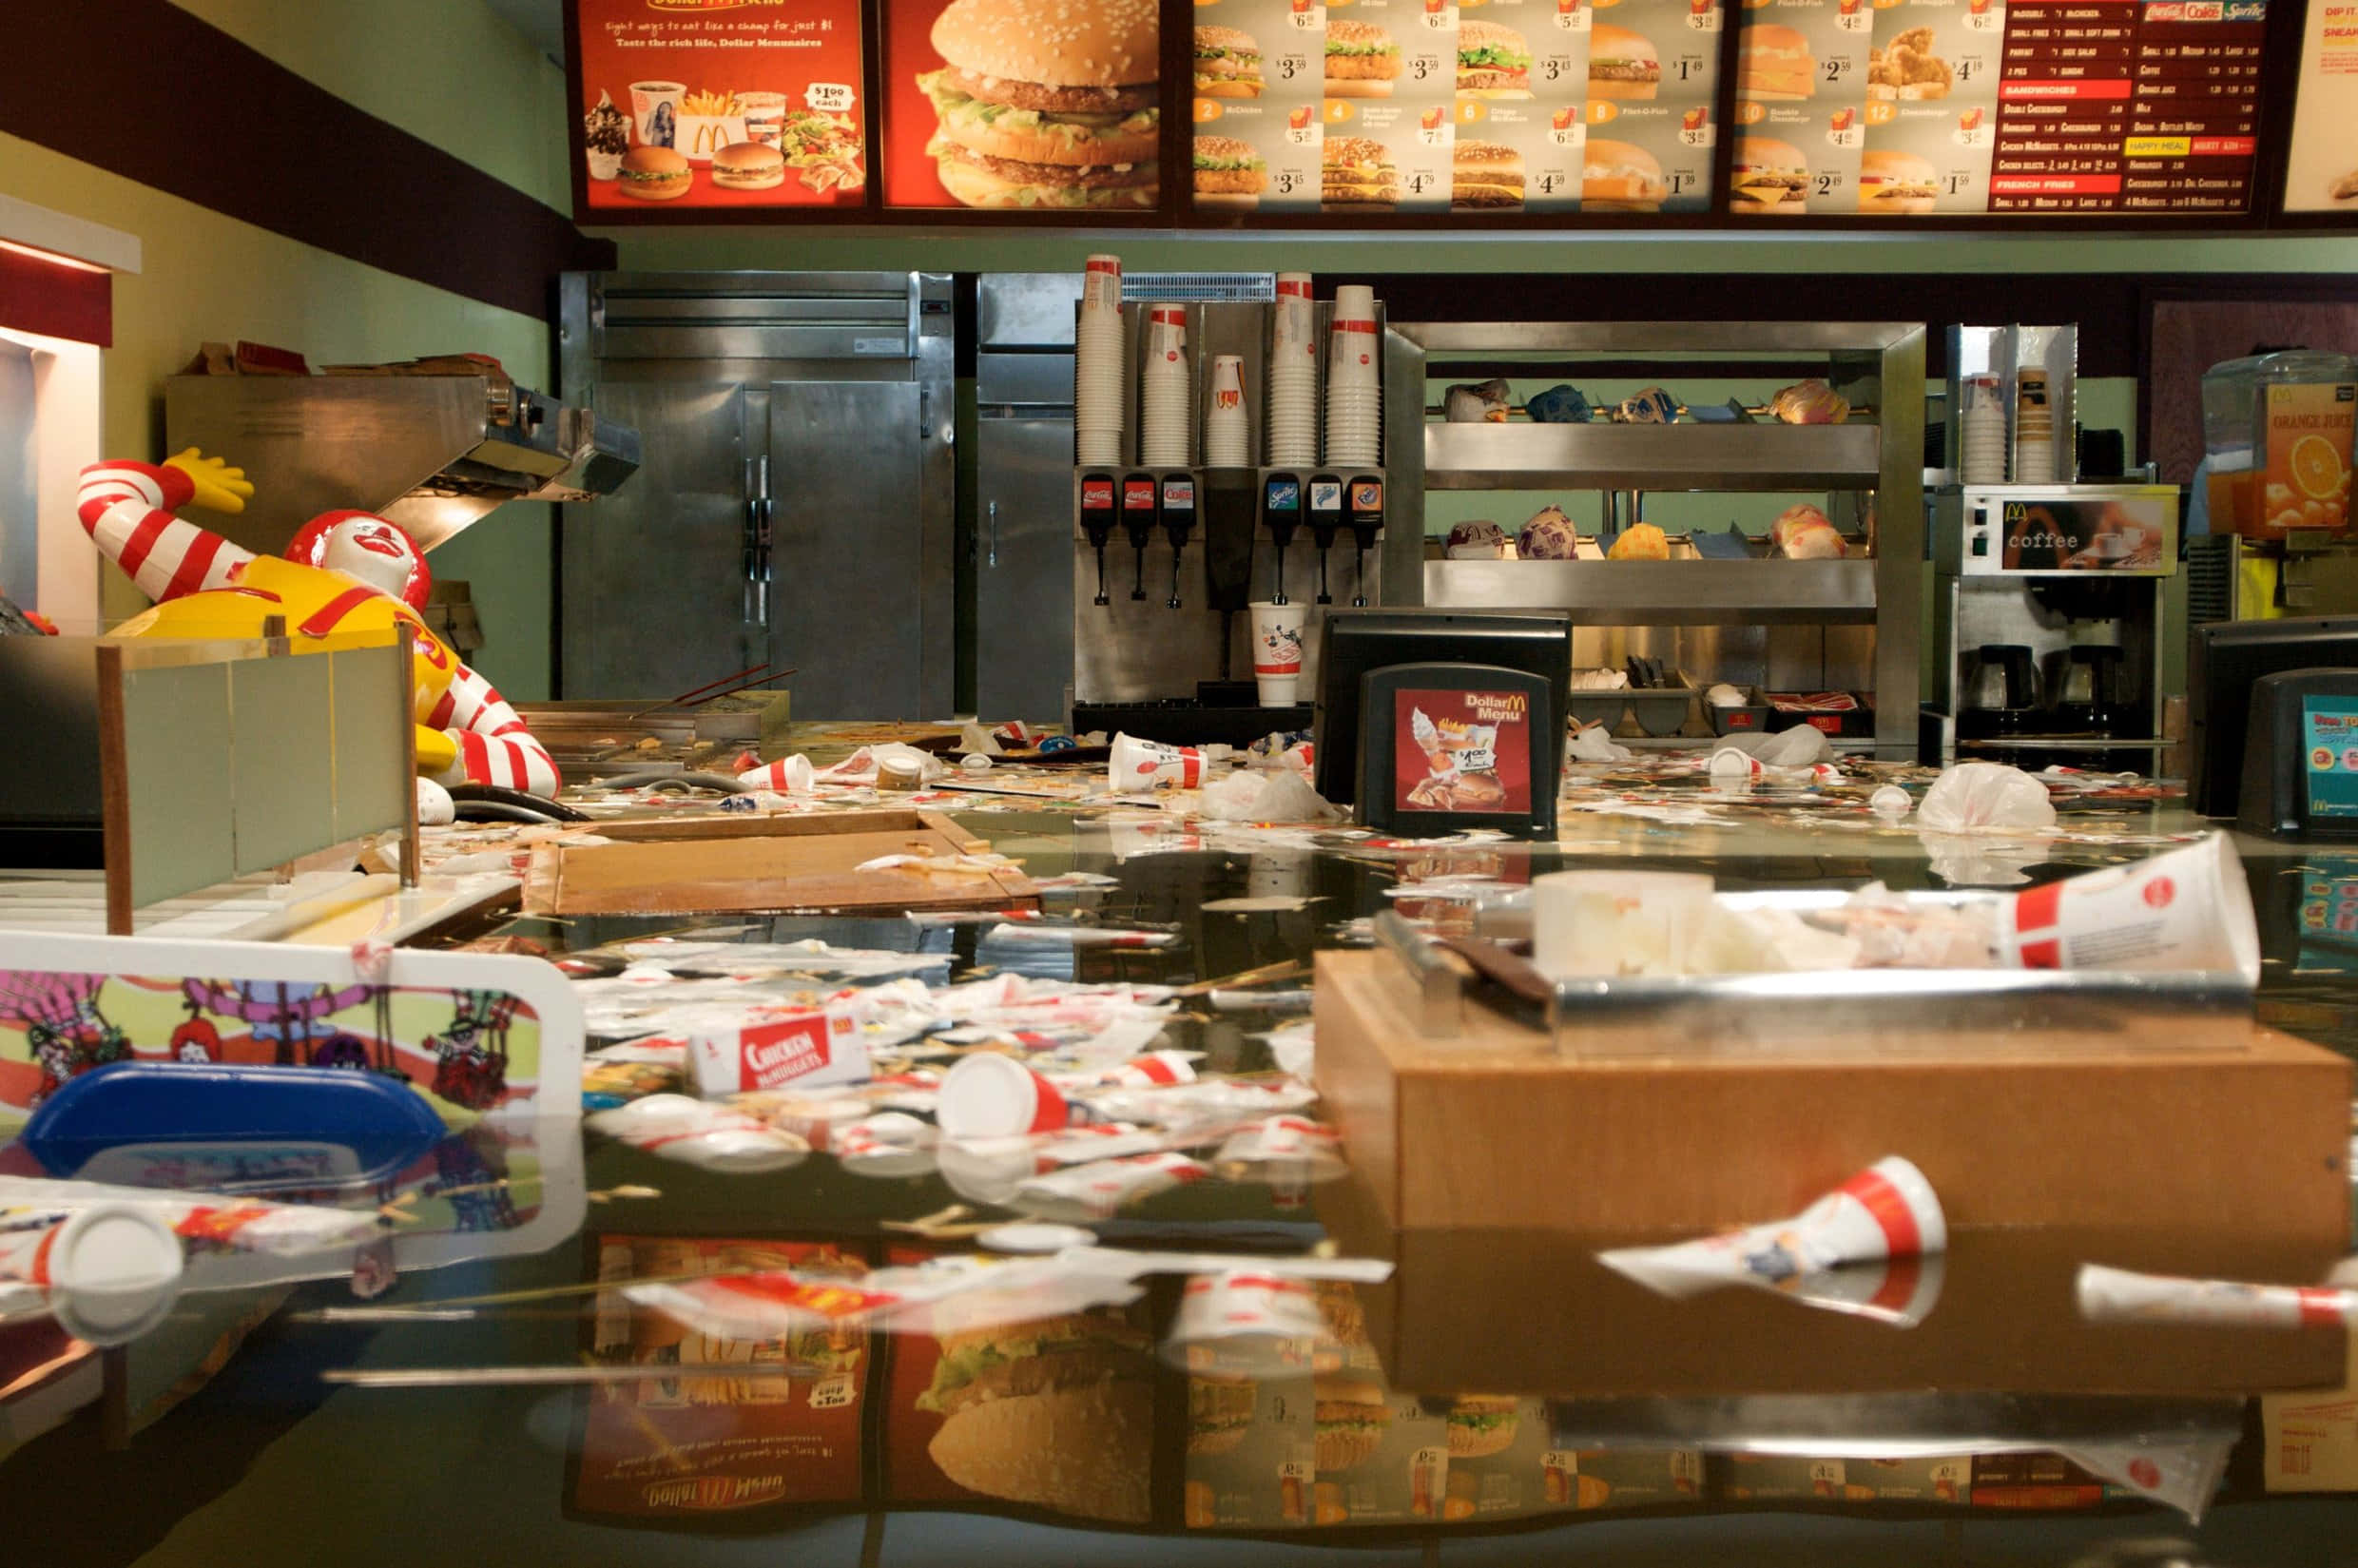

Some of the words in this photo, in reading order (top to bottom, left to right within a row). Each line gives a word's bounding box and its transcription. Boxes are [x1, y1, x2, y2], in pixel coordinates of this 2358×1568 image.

[616, 38, 646, 47] Taste
[647, 38, 667, 47] the
[669, 38, 692, 47] rich
[720, 38, 755, 47] Dollar
[2005, 87, 2078, 95] SANDWICHES
[1203, 104, 1213, 118] 2
[1332, 104, 1343, 119] 4
[1622, 106, 1670, 115] Filet-O-Fish
[1870, 105, 1890, 122] 12
[2130, 142, 2158, 150] HAPPY
[1997, 181, 2040, 189] FRENCH
[2044, 181, 2076, 189] FRIES
[2273, 414, 2321, 428] ORANGE
[2008, 532, 2078, 549] coffee
[1465, 695, 1507, 707] Dollar
[1477, 707, 1521, 721] Menu
